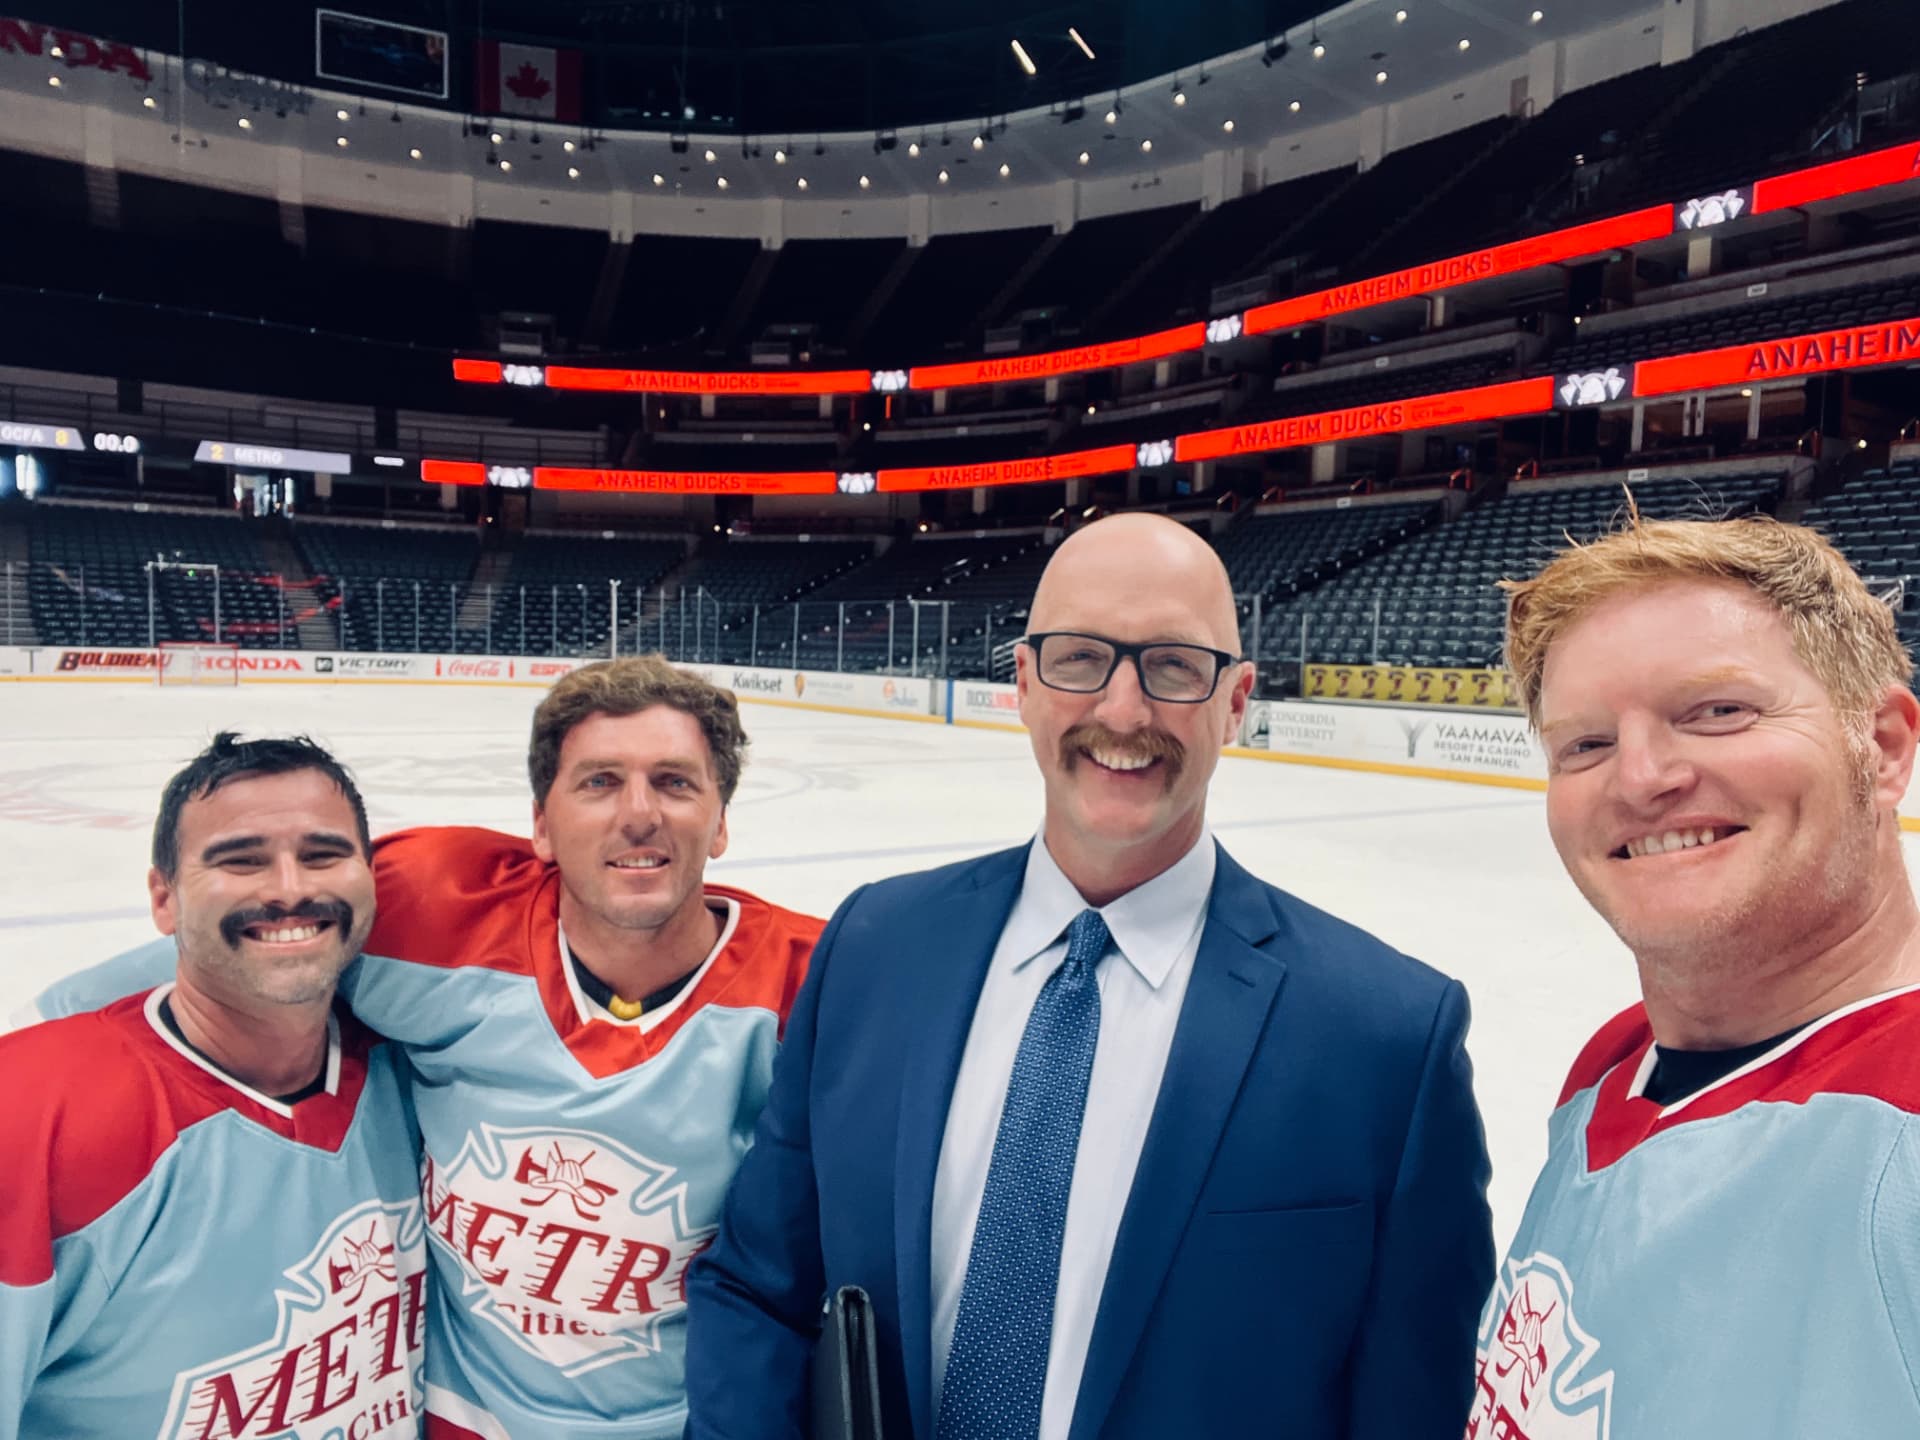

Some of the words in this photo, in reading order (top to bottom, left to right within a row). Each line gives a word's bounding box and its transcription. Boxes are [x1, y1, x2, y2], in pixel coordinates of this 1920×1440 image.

[1321, 276, 1410, 311] ANAHEIM
[1422, 252, 1494, 287] DUCKS
[1748, 327, 1920, 376] ANAHEIM
[977, 358, 1047, 379] ANAHEIM
[1052, 347, 1101, 370] DUCKS
[624, 372, 700, 388] ANAHEIM
[707, 374, 760, 389] DUCKS
[1231, 420, 1323, 451] ANAHEIM
[1329, 404, 1403, 435] DUCKS
[210, 444, 224, 461] 2
[234, 446, 284, 466] METRO
[595, 474, 680, 491] ANAHEIM
[685, 475, 741, 490] DUCKS
[928, 468, 999, 487] ANAHEIM
[1003, 457, 1054, 479] DUCKS
[57, 651, 172, 671] BOUDREAU
[338, 656, 412, 669] VICTORY
[732, 672, 782, 694] Kwikset
[1434, 740, 1475, 753] RESORT
[1488, 745, 1531, 758] CASINO
[1450, 752, 1472, 763] SAN
[1474, 755, 1520, 768] MANUEL
[420, 1153, 715, 1316] METR
